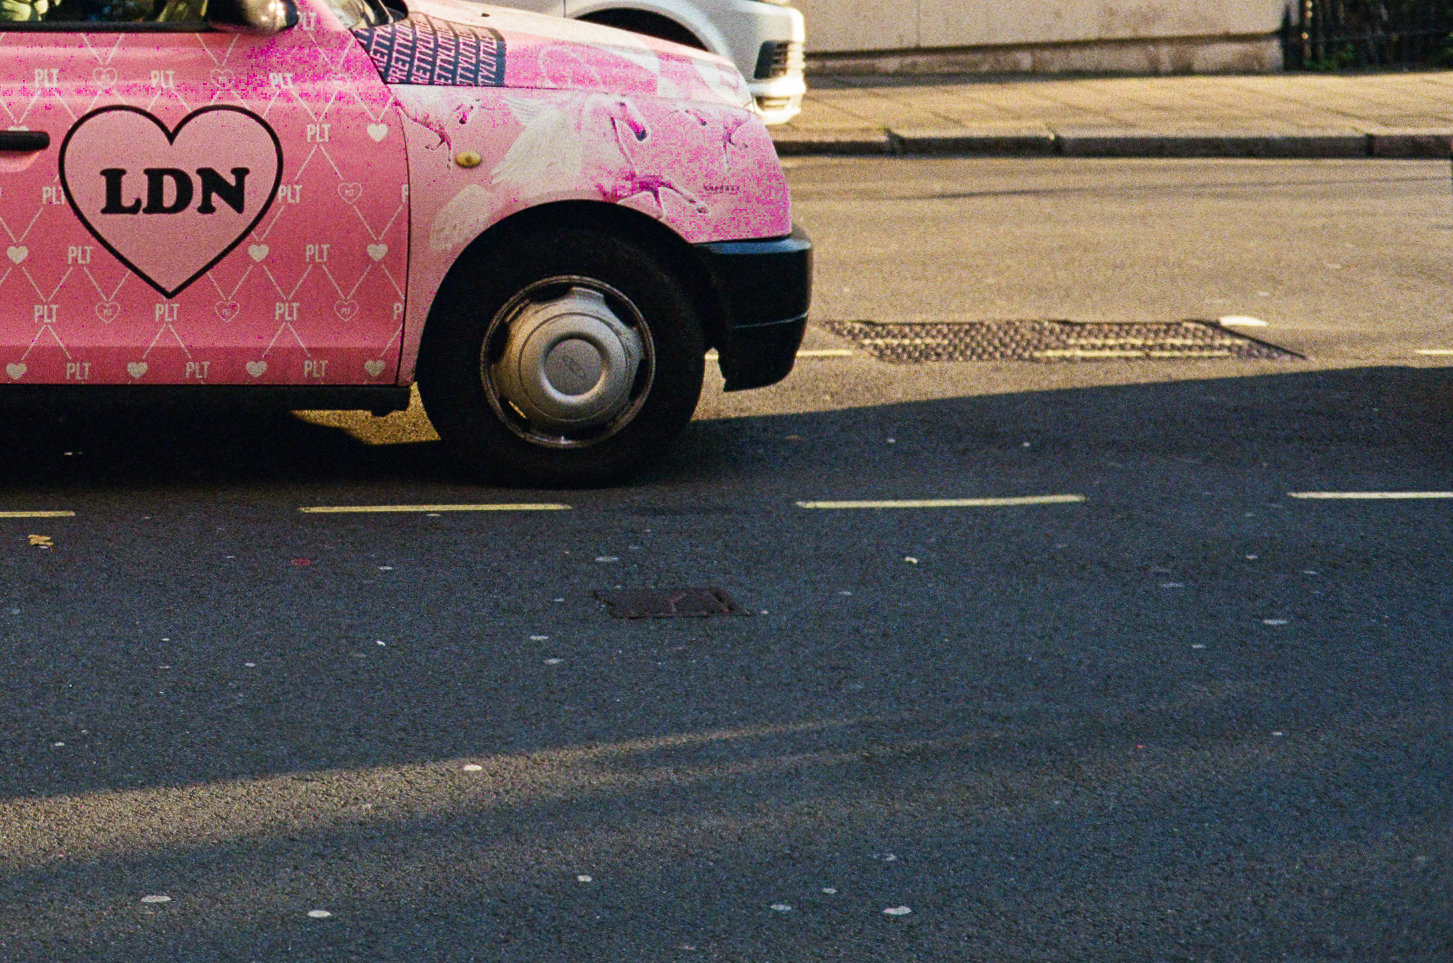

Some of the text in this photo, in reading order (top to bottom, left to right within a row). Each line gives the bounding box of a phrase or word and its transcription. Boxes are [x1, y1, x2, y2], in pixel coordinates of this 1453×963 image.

[34, 69, 59, 88] PLT
[150, 70, 174, 89] PLT
[269, 73, 294, 89] PLT
[306, 124, 330, 143] PLT
[100, 168, 250, 215] LDN
[277, 185, 302, 204] PLT
[67, 246, 93, 265] PLT
[305, 244, 330, 262] PLT
[34, 304, 58, 323] PLT
[155, 303, 180, 321] PLT
[274, 303, 299, 321] PLT
[66, 363, 91, 380] PLT
[185, 362, 210, 379] PLT
[303, 360, 328, 378] PLT
